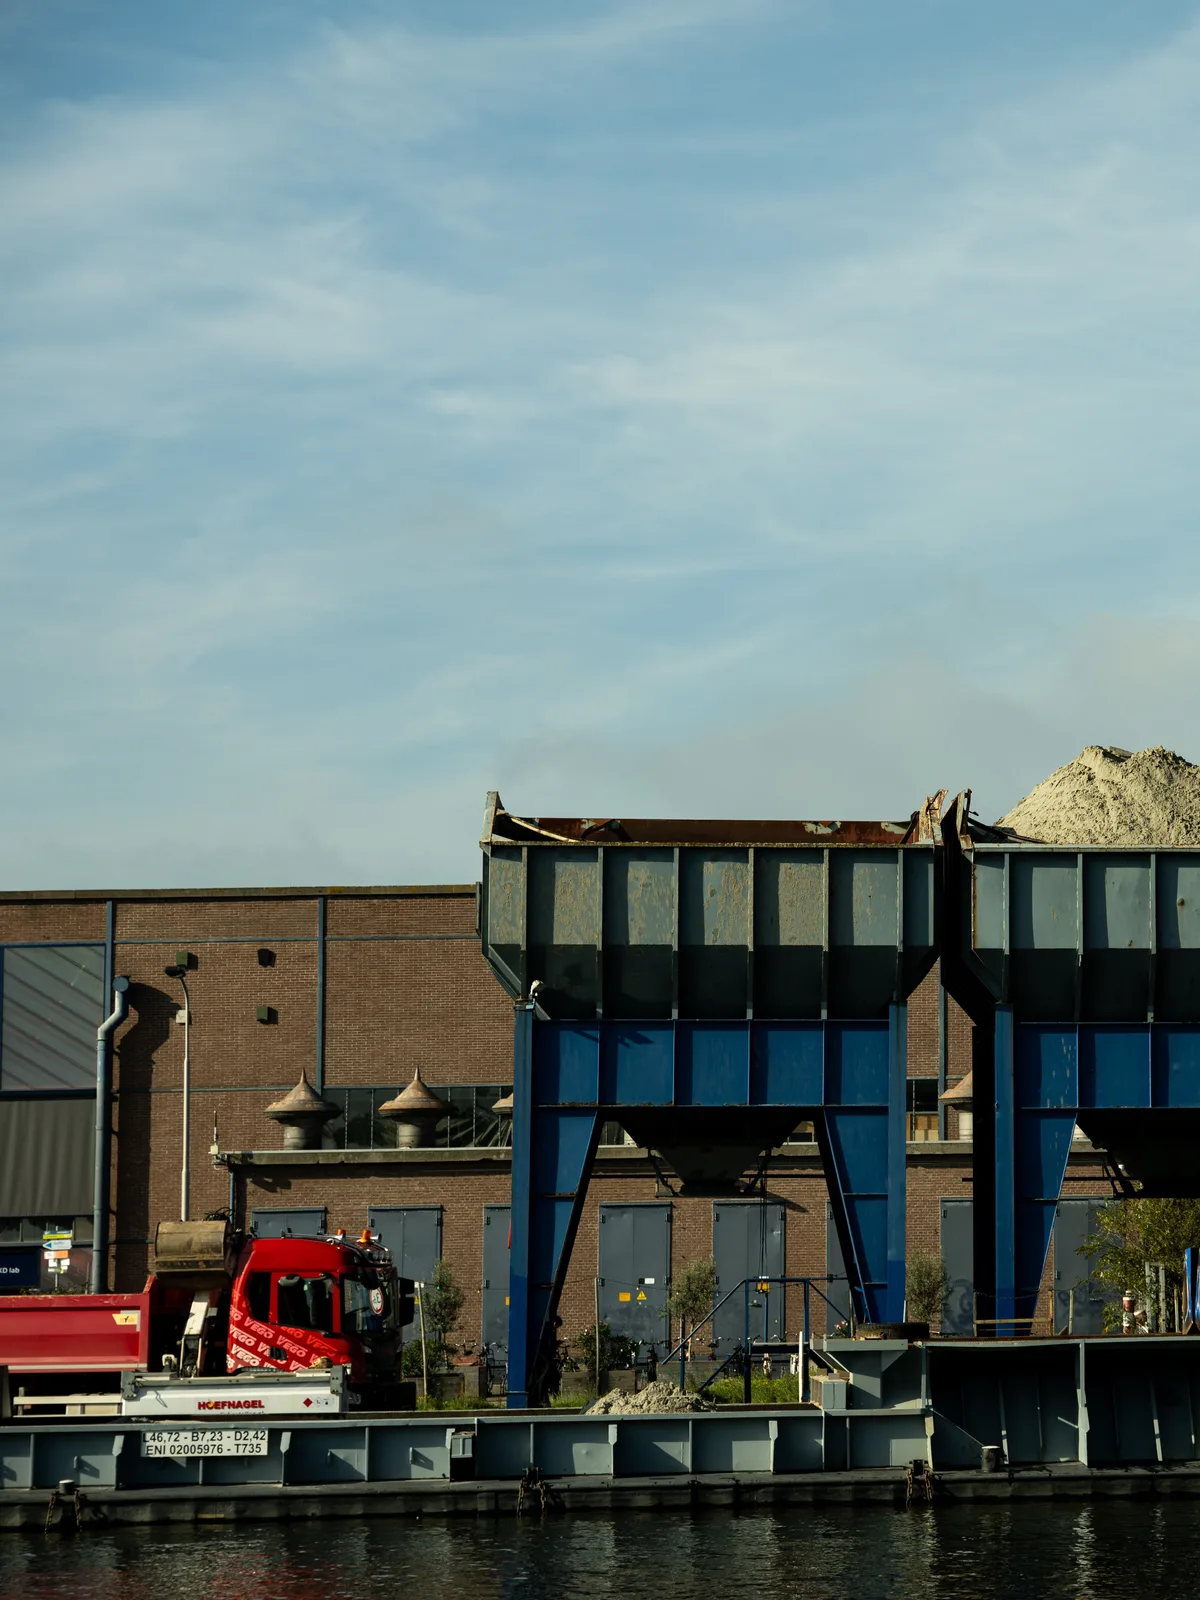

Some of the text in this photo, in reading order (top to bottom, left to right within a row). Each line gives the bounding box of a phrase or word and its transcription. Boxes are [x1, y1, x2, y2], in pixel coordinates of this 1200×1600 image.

[9, 1266, 20, 1274] lab
[229, 1323, 257, 1347] VEGO
[243, 1316, 275, 1339] VEGO
[231, 1343, 262, 1367] VEGO
[276, 1335, 308, 1358] VEGO
[197, 1399, 265, 1411] HOEFNAGEL
[142, 1431, 180, 1444] L46,72
[191, 1431, 223, 1443] B7,23
[234, 1430, 266, 1443] D2,42
[146, 1445, 166, 1455] ENI
[169, 1443, 223, 1455] 02005976
[234, 1443, 262, 1454] T735
